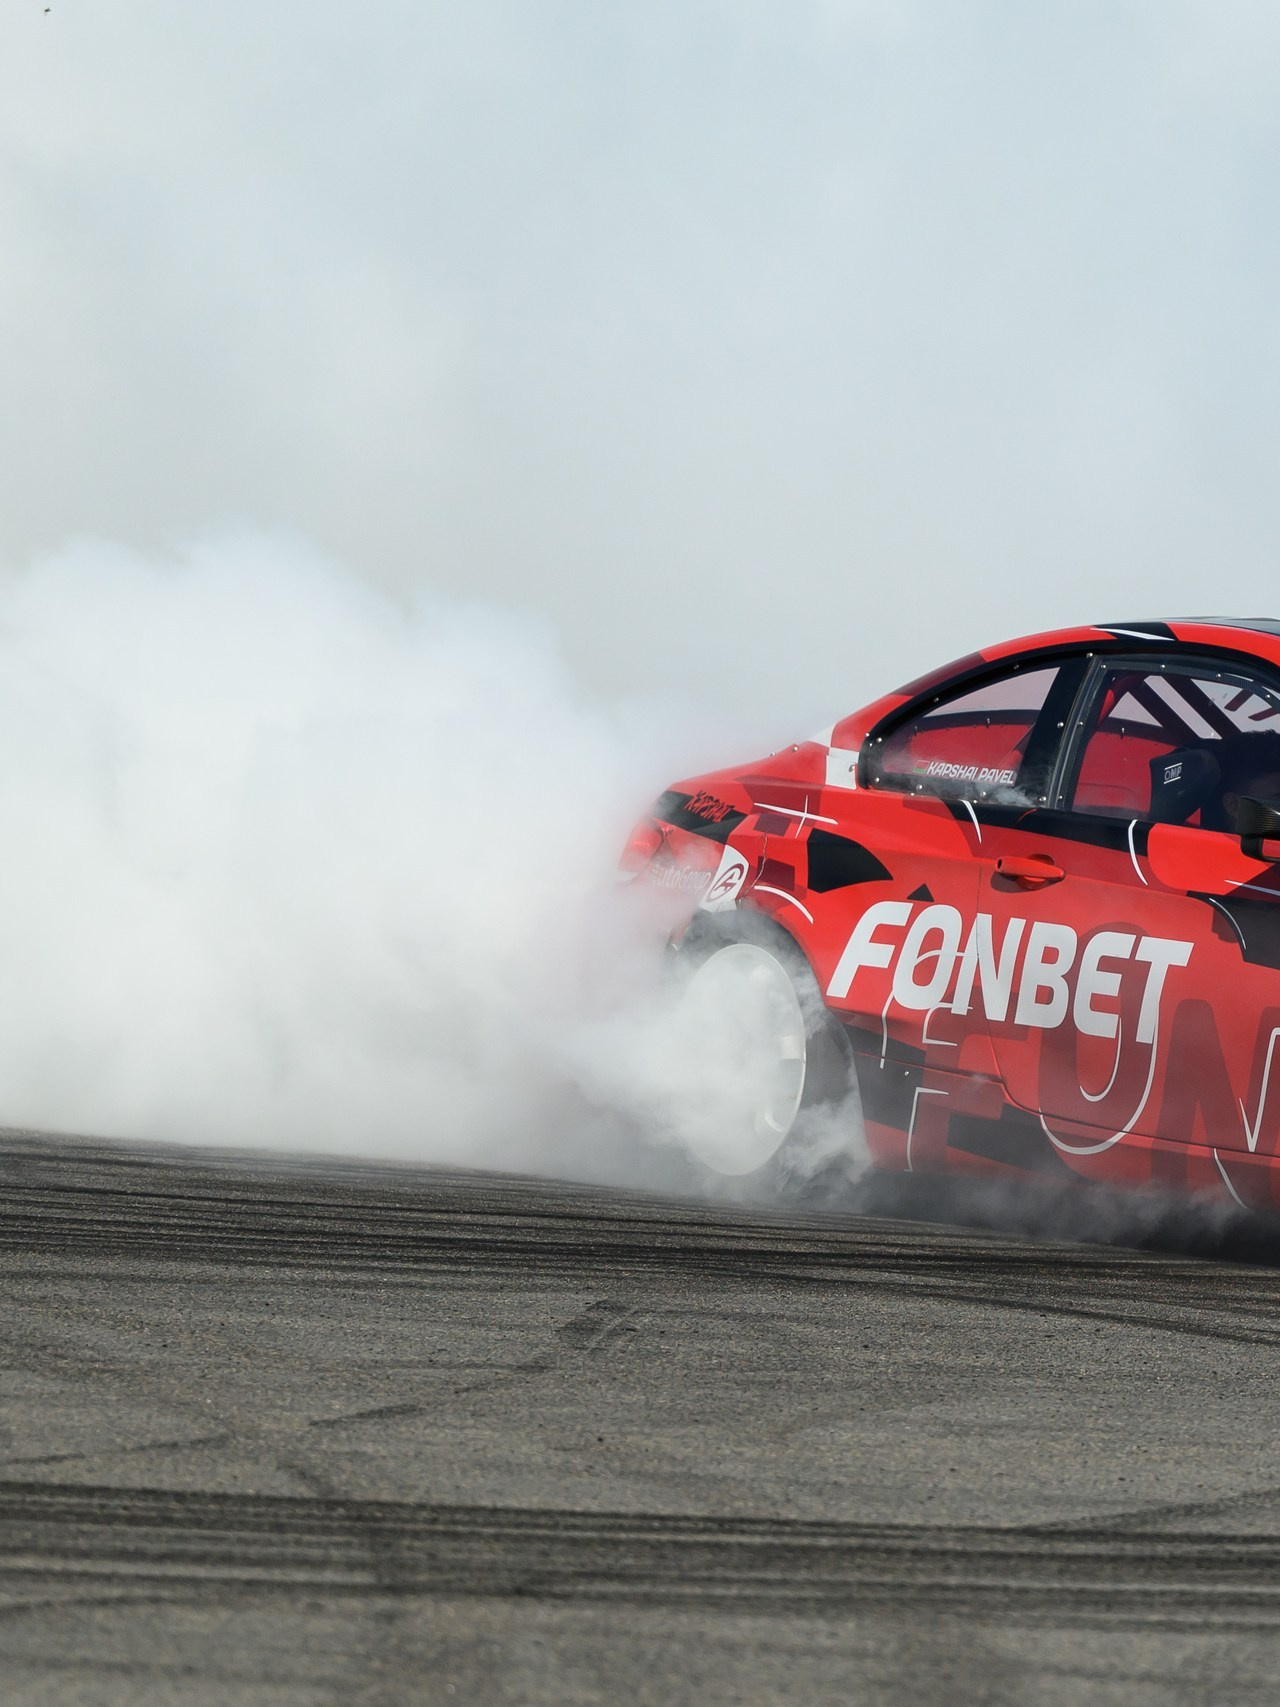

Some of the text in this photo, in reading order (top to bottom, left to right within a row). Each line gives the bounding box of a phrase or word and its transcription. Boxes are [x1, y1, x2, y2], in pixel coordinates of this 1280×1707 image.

[926, 762, 1014, 784] KAPSHAI PAVEL
[826, 901, 1195, 1045] FONBET
